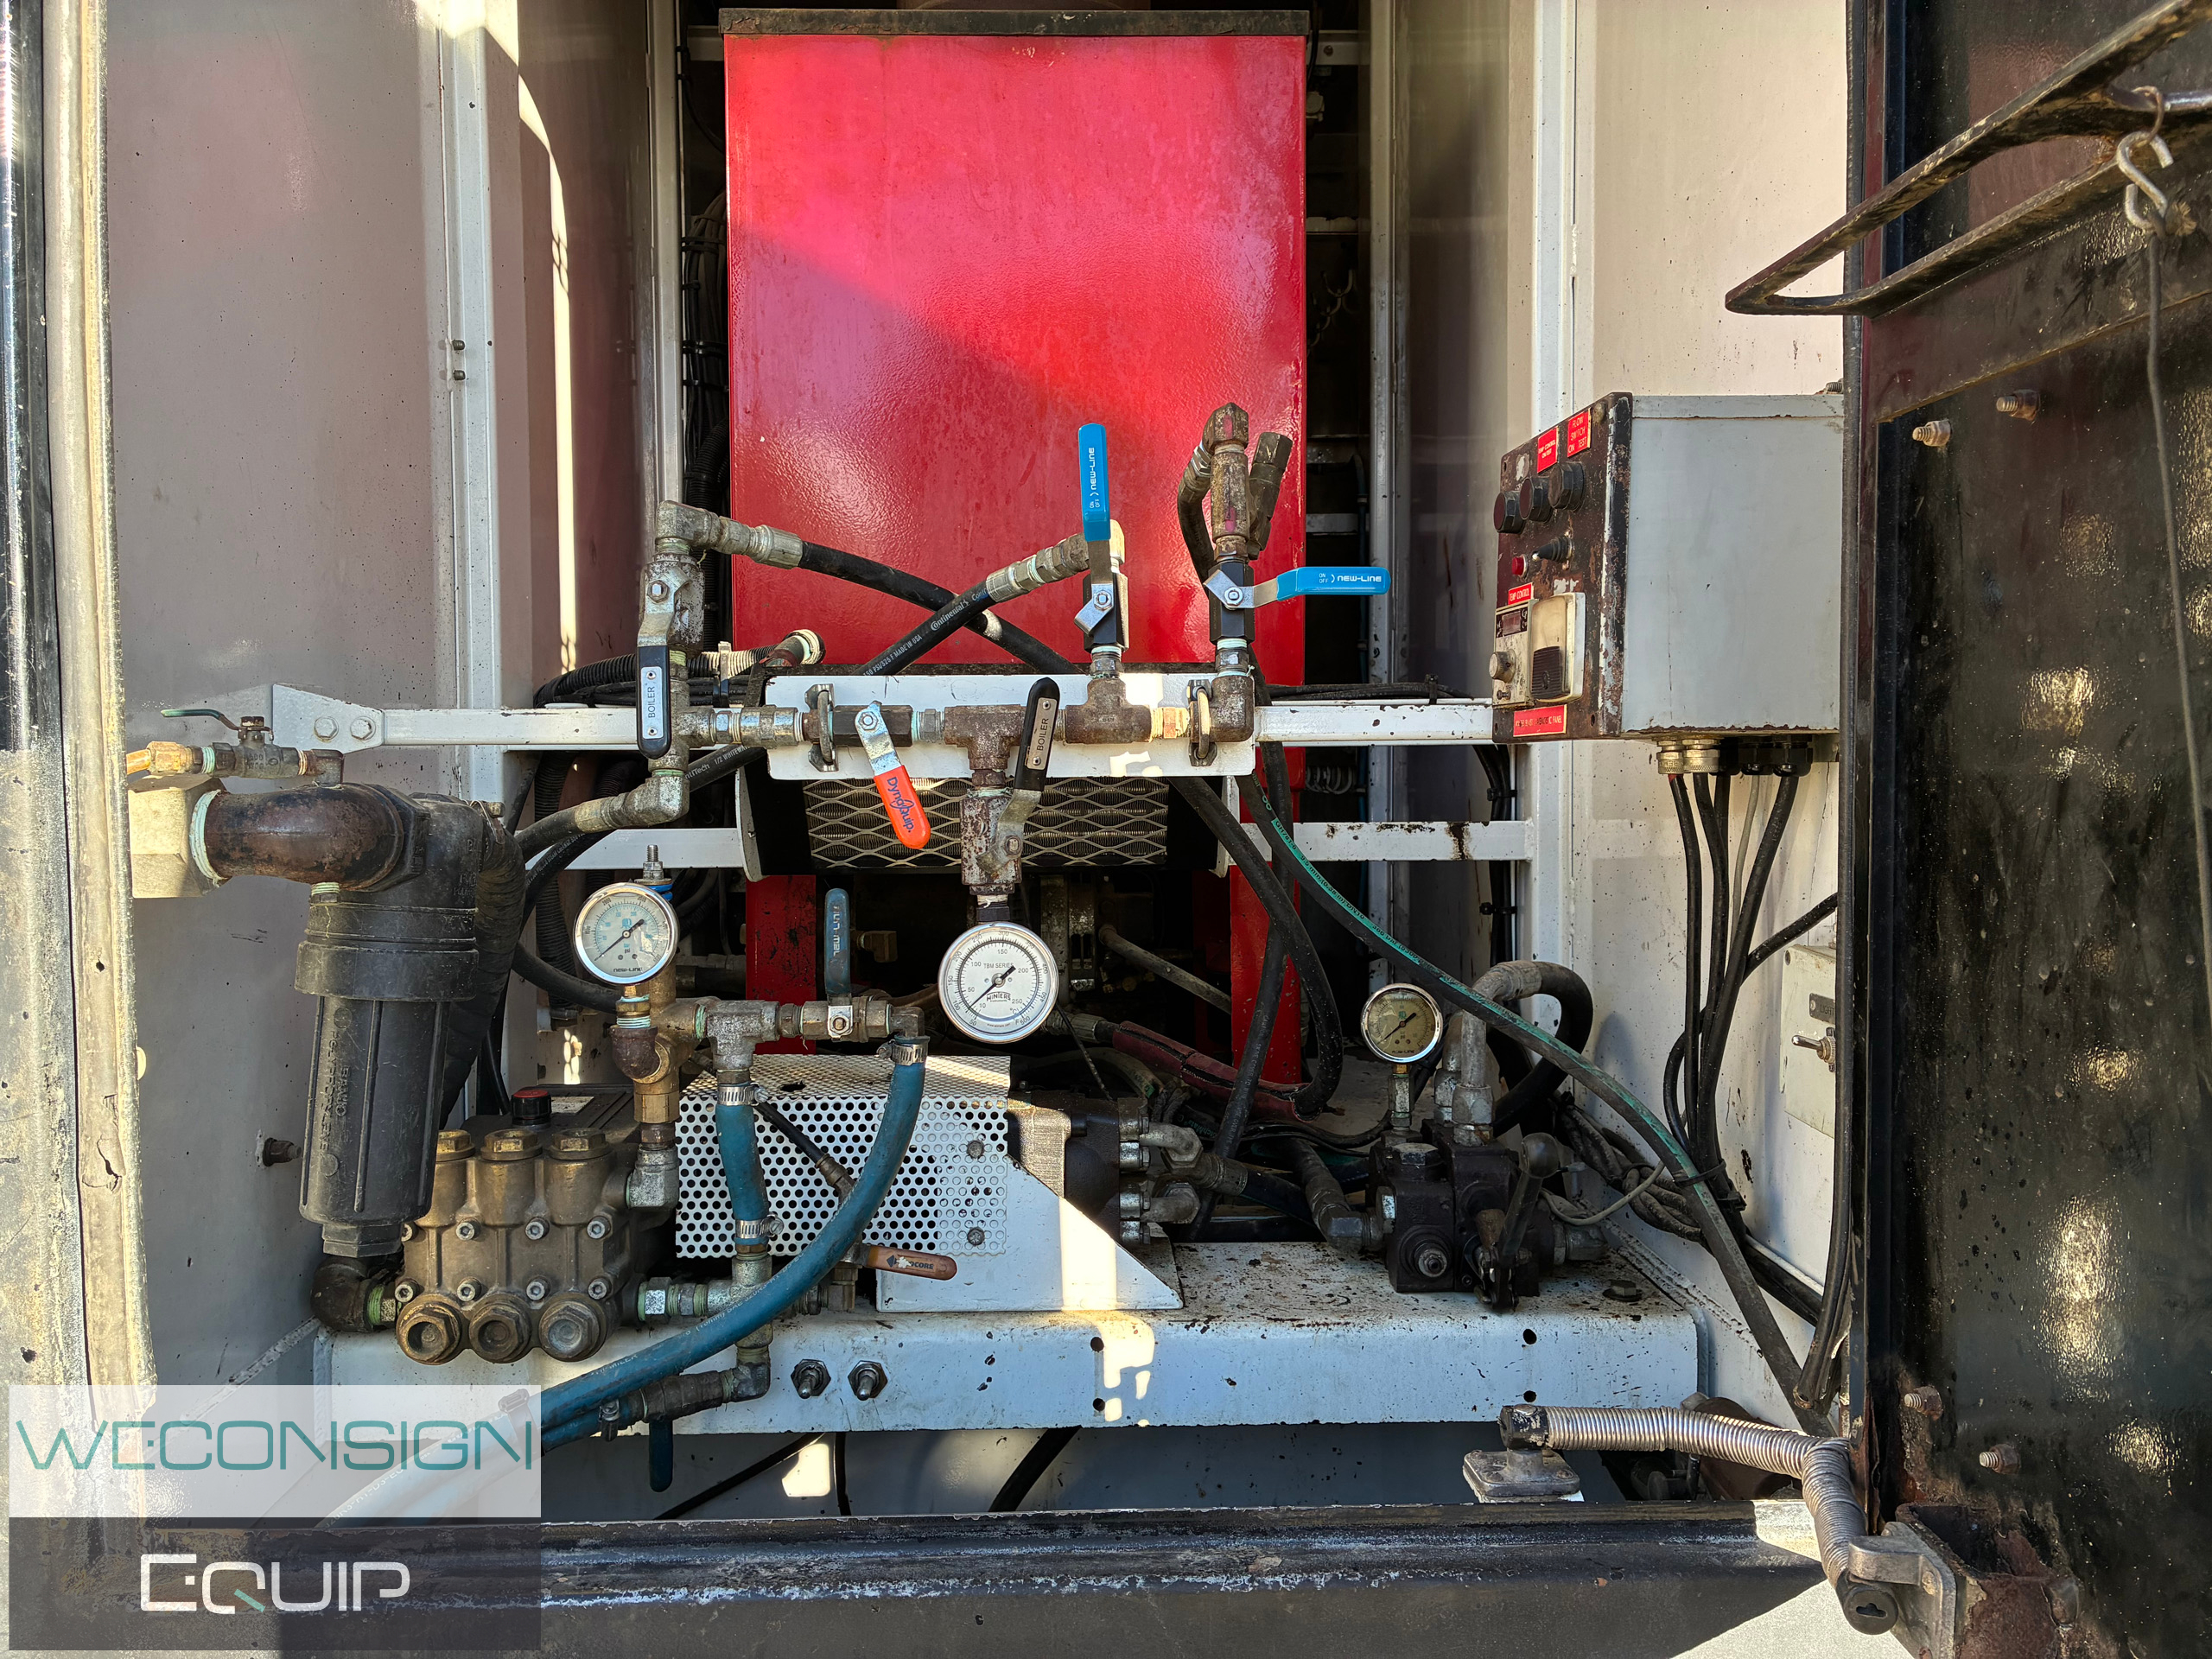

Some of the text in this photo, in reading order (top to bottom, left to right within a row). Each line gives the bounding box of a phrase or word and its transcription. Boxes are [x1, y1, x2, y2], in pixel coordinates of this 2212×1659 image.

[1573, 416, 1584, 428] FLOW
[1571, 427, 1586, 441] SWITCH
[1545, 440, 1555, 450] CONTROL
[1568, 444, 1575, 453] ON
[1516, 588, 1529, 600] CONTROL
[931, 601, 964, 631] Continental
[893, 645, 908, 658] MADE
[911, 633, 923, 645] USA
[647, 686, 656, 719] BOILER
[1553, 715, 1562, 724] PANEL
[1037, 717, 1049, 752] BOILER
[684, 763, 710, 779] ntiTech
[714, 756, 723, 765] 1/2
[972, 934, 982, 943] 250
[1025, 940, 1035, 949] 350
[987, 991, 1011, 1001] WINTERS
[1020, 1016, 1031, 1025] 500
